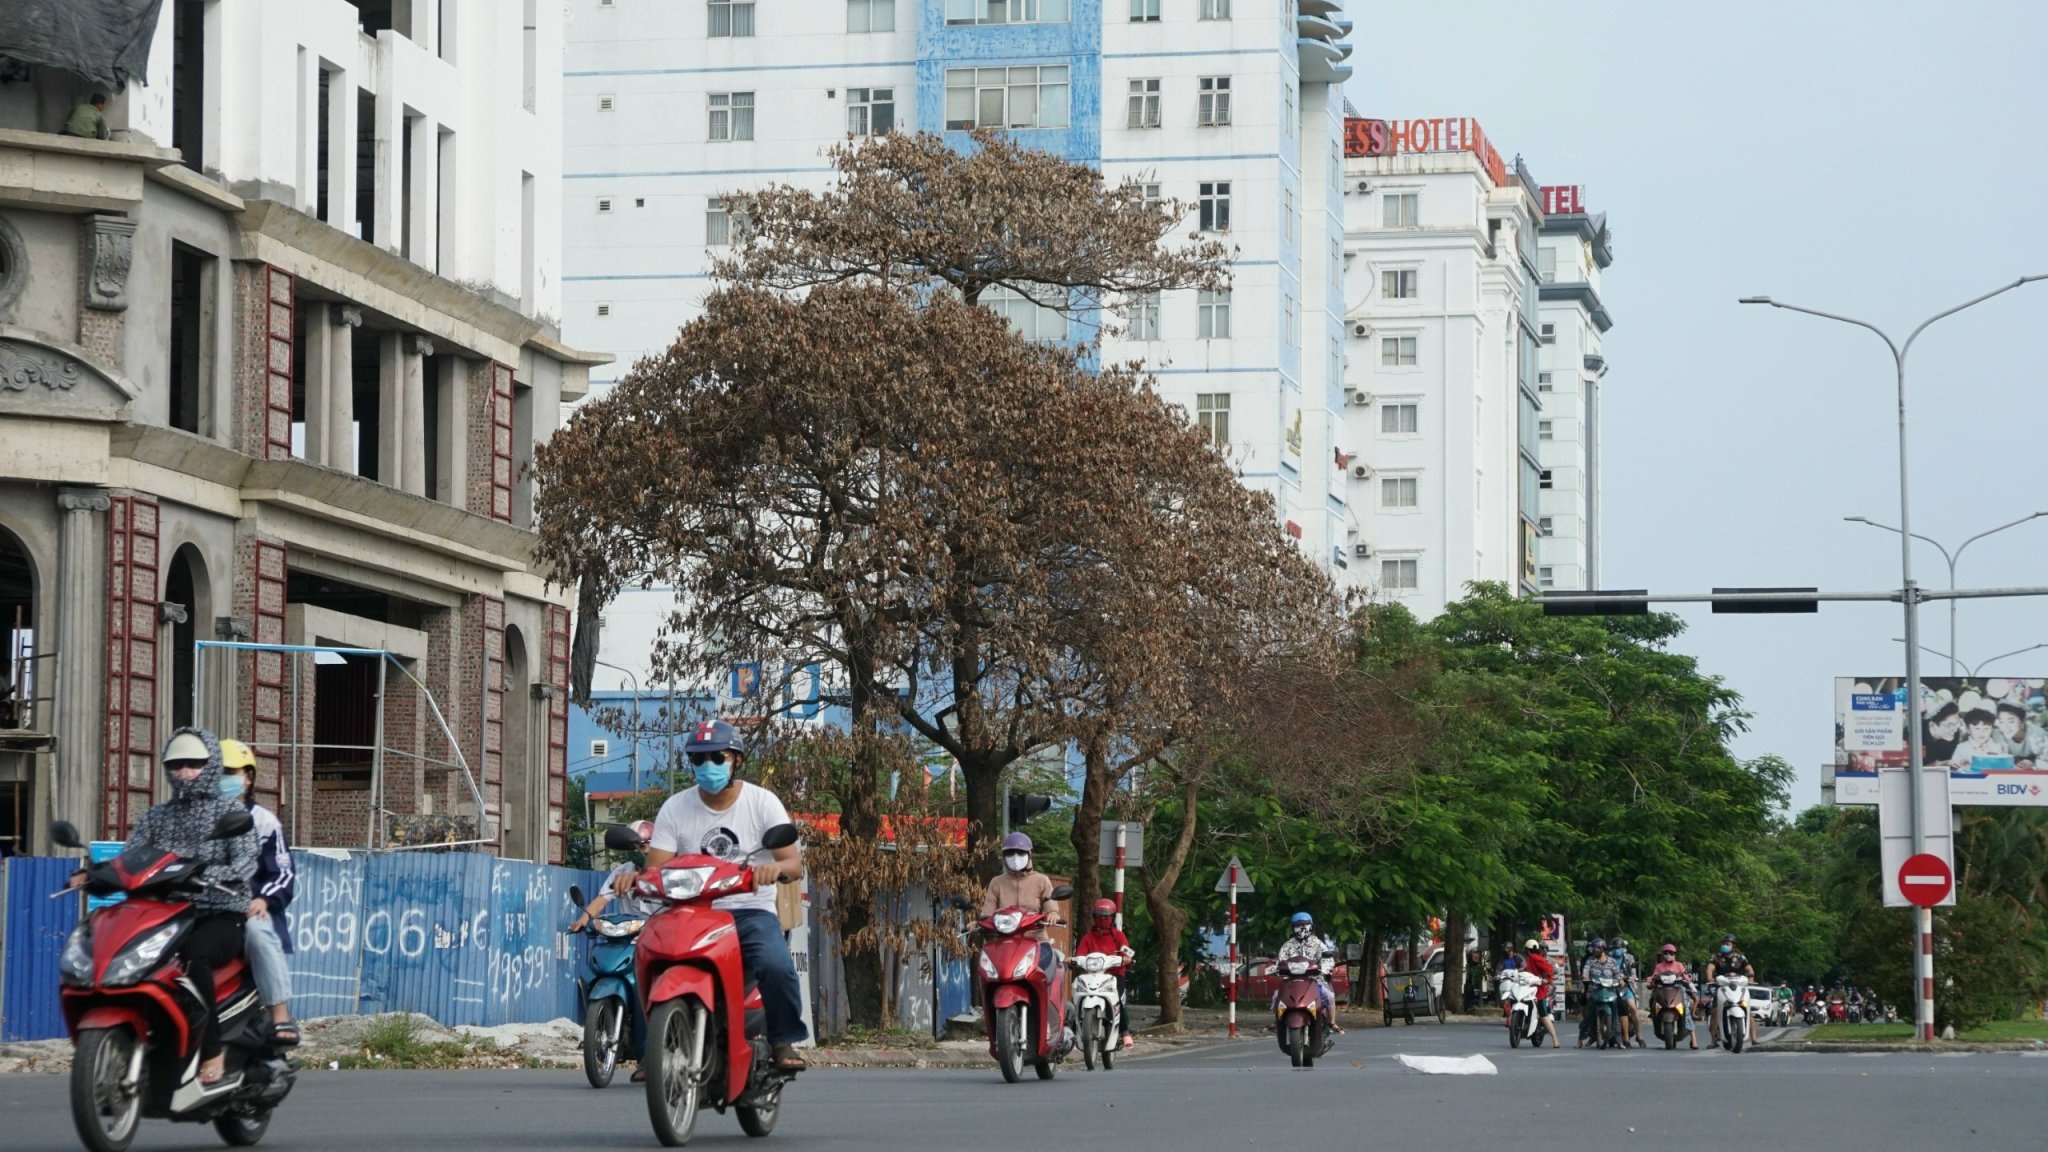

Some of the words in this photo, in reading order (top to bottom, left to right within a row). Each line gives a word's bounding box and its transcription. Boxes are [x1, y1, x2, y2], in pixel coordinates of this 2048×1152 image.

[1391, 117, 1473, 153] HOTEL
[1540, 185, 1585, 214] TEL
[1997, 783, 2028, 796] BIDV
[319, 864, 365, 905] ĐẤT
